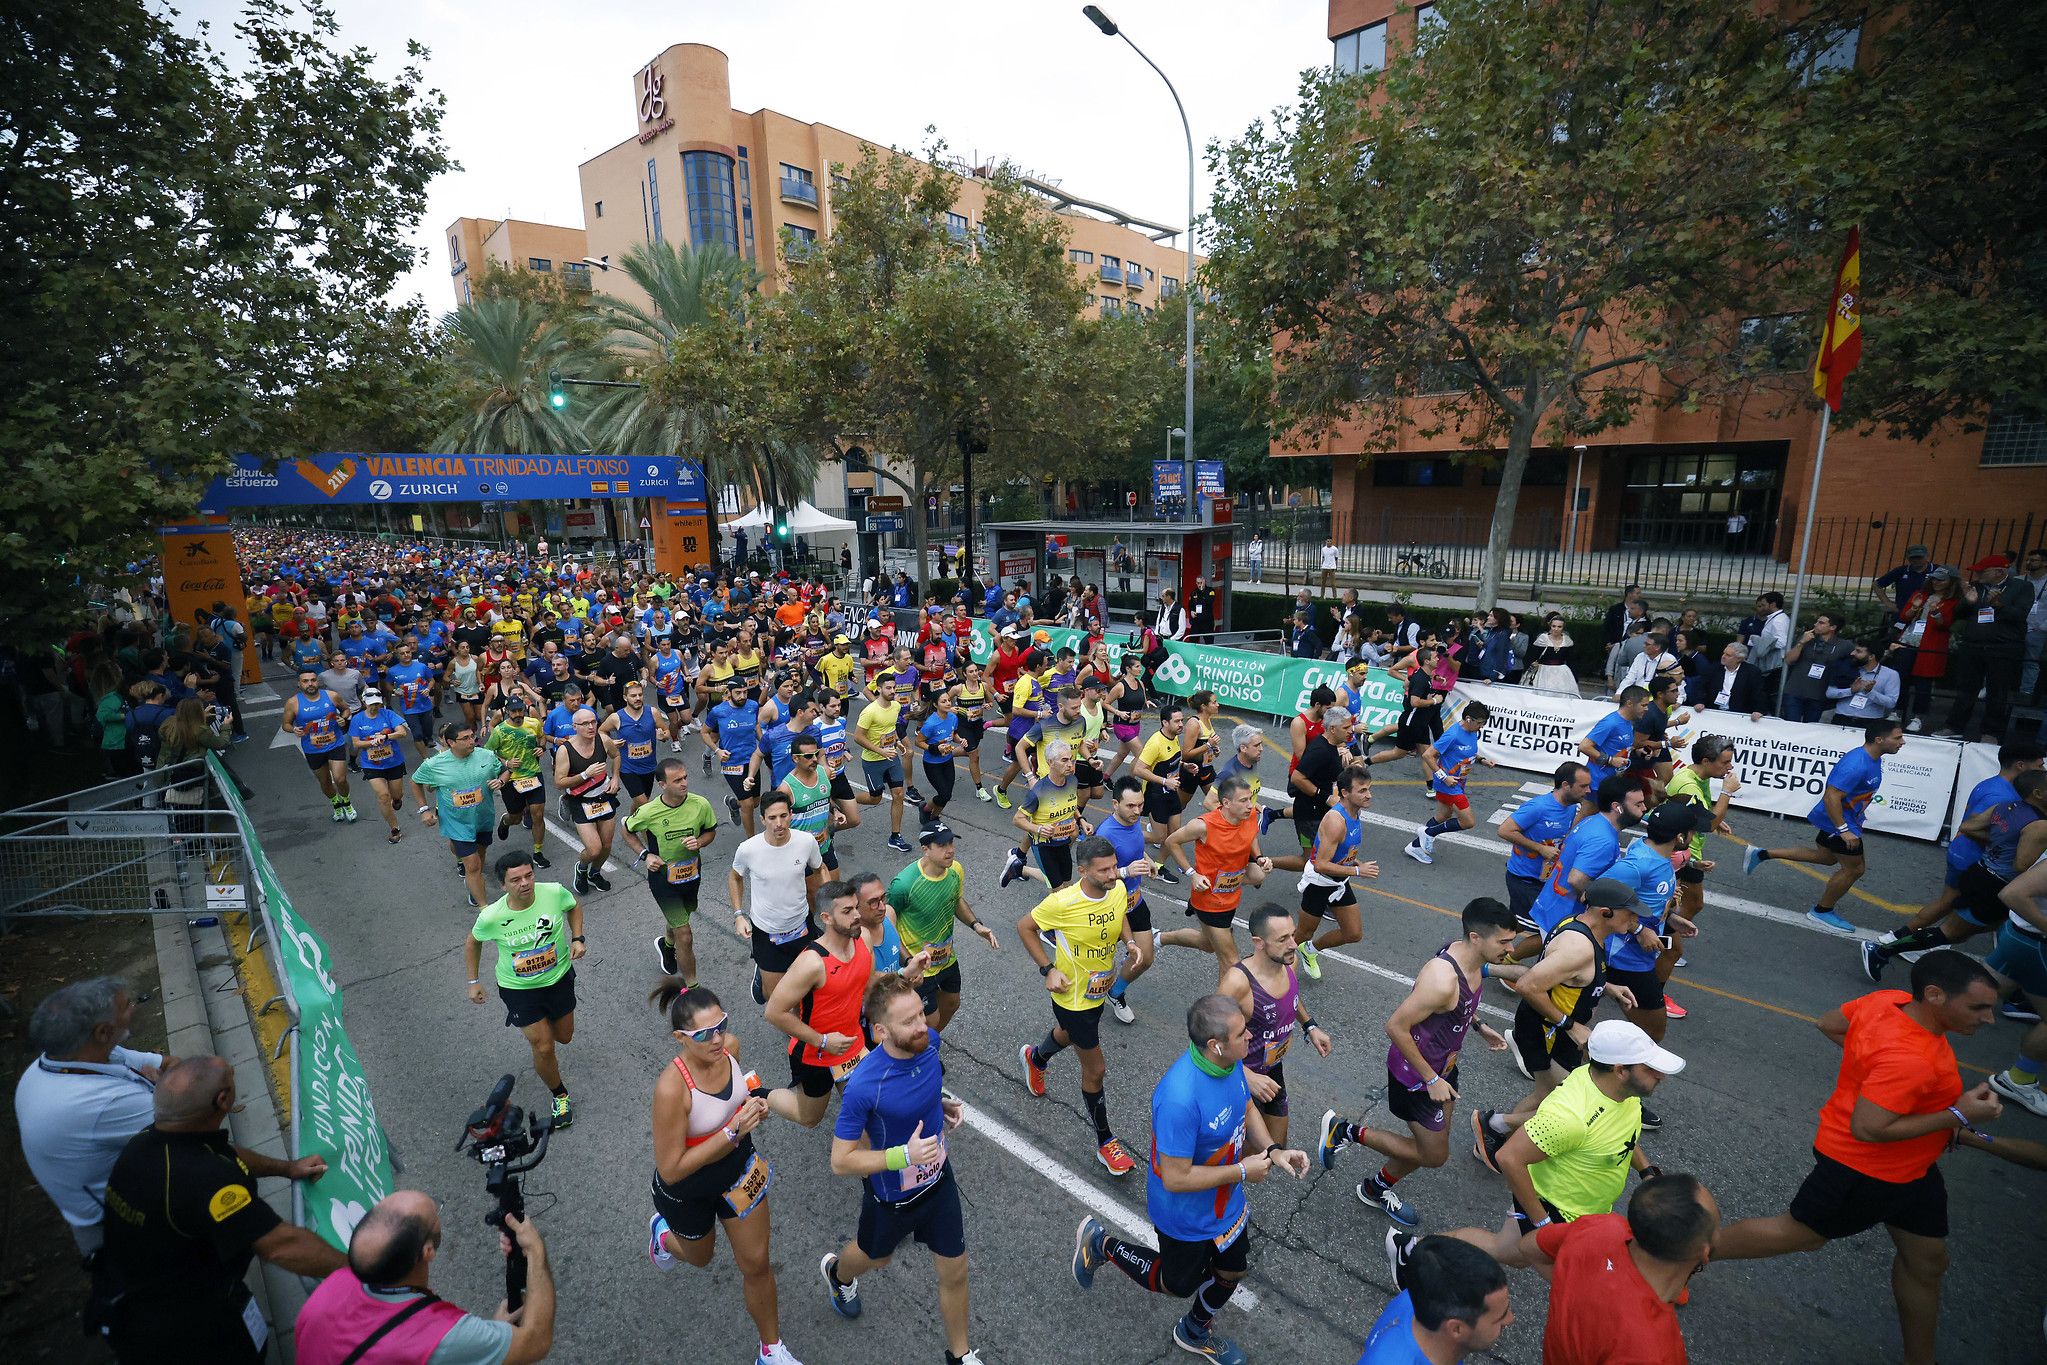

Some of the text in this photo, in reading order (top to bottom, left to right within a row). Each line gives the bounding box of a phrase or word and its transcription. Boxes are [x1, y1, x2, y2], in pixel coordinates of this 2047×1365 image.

[366, 457, 629, 477] VALENCIA TRINIDAD ALFONSO
[226, 477, 279, 487] Esfuerzo
[327, 470, 350, 490] 21K
[639, 479, 669, 487] ZURICH
[400, 483, 458, 496] ZURICH
[894, 518, 904, 529] 10
[1005, 565, 1032, 576] VALENCIA
[1198, 653, 1267, 672] FUNDACIÓN
[1195, 664, 1265, 688] TRINIDAD
[1520, 709, 1576, 724] Valenciana
[1487, 714, 1574, 740] MUNITAT
[1771, 740, 1846, 759] Valenciana
[1887, 762, 1933, 773] GENERALITAT
[1887, 767, 1932, 778] VALENCIANA
[1740, 768, 1825, 795] L'ESPO
[1049, 804, 1077, 819] BALEAR
[1889, 805, 1926, 815] ALFONSO
[1890, 800, 1927, 810] TRINIDAD
[1101, 928, 1108, 940] 6
[516, 957, 556, 974] CARRERAS
[311, 1011, 338, 1151] FUNDACIÓN
[742, 1168, 760, 1192] 5559
[915, 1162, 940, 1183] Paolo
[747, 1175, 767, 1201] Keka
[1115, 1244, 1153, 1275] Kalenji
